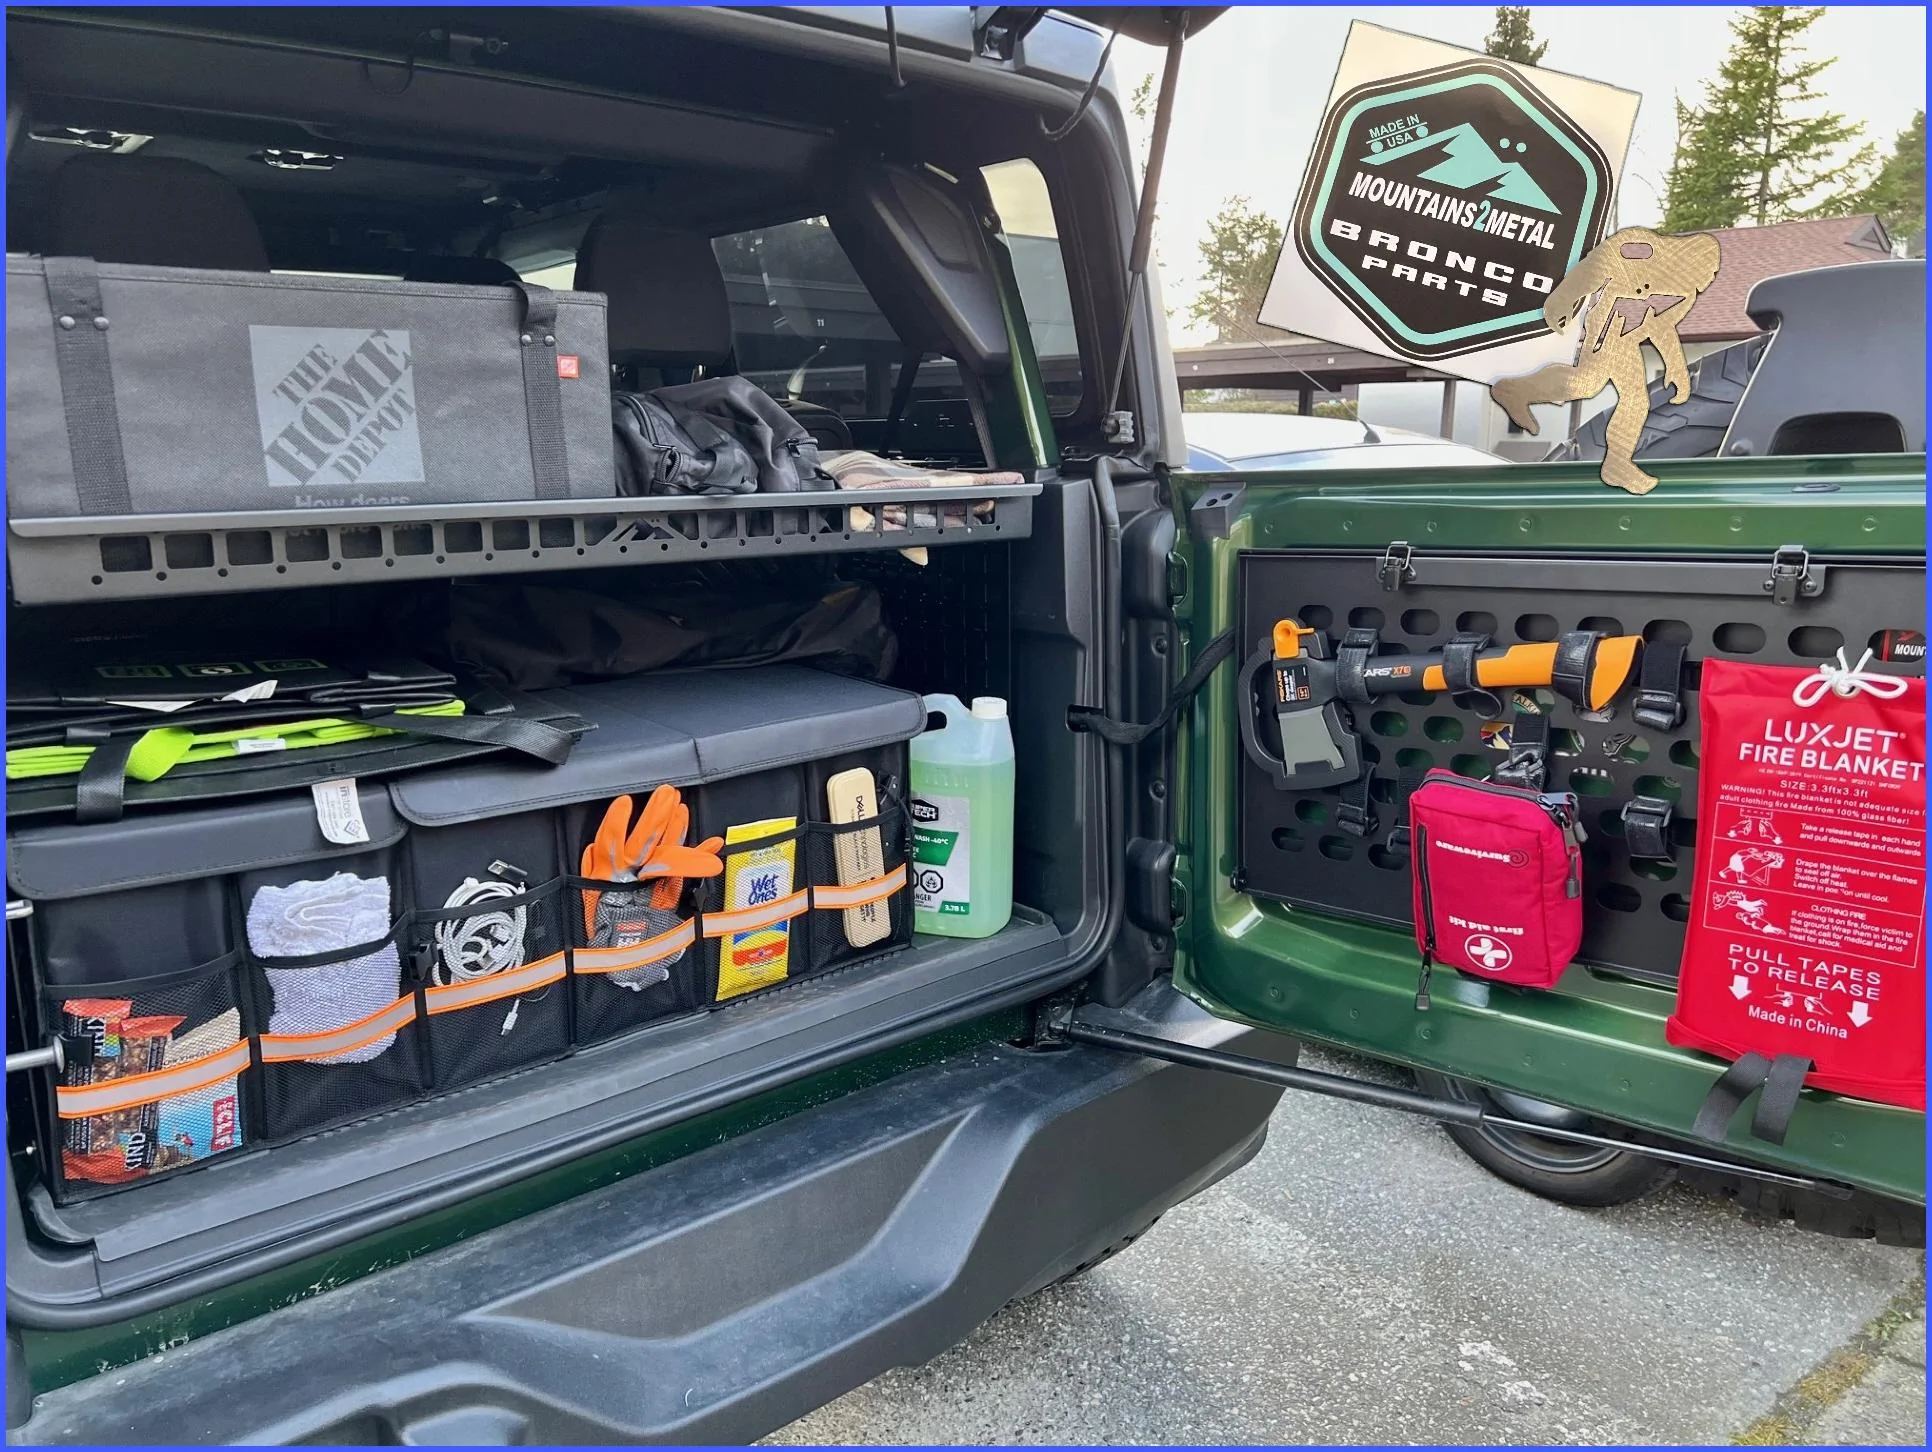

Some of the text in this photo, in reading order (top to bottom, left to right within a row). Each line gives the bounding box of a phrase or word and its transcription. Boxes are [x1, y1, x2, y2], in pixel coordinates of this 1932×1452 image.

[272, 343, 338, 406] THE
[264, 329, 413, 487] HOME
[331, 388, 415, 482] DEPOT
[1738, 742, 1925, 781] FIRE BLANKET
[1719, 794, 1740, 802] adult
[1740, 796, 1773, 808] clothing
[1774, 800, 1789, 809] fire
[1790, 803, 1813, 812] Made
[1814, 805, 1834, 814] from
[1836, 808, 1860, 818] 100%
[1861, 812, 1885, 822] glass
[1720, 783, 1765, 795] WARNING!
[1767, 789, 1785, 798] This
[1786, 791, 1800, 800] fire
[1801, 793, 1832, 804] blanket
[1833, 796, 1841, 805] is
[1843, 799, 1857, 807] not
[1859, 801, 1899, 813] adequate
[1901, 807, 1920, 816] size
[911, 809, 936, 819] ECH
[1799, 832, 1922, 857] and pull downwards and outwards
[1800, 822, 1818, 831] Take
[1825, 827, 1852, 837] release
[1853, 830, 1870, 840] tape
[1870, 832, 1878, 840] in
[1881, 834, 1900, 843] each
[1901, 837, 1921, 847] hand
[750, 873, 779, 892] Wet
[1794, 872, 1819, 882] Switch
[1819, 877, 1830, 885] off
[1819, 862, 1831, 870] the
[1832, 864, 1860, 875] blanket
[1860, 869, 1878, 878] over
[1878, 872, 1891, 880] the
[1891, 874, 1918, 885] flames
[748, 888, 778, 905] Ones
[914, 892, 932, 902] NGER
[1793, 880, 1816, 890] Leave
[1816, 883, 1825, 892] in
[1824, 886, 1854, 897] posion
[1854, 891, 1871, 899] until
[1448, 915, 1467, 928] kit
[1468, 921, 1492, 931] aid
[1790, 917, 1803, 926] the
[1852, 928, 1872, 939] them
[1872, 932, 1880, 940] in
[1880, 934, 1894, 942] the
[1894, 936, 1909, 946] fire
[1797, 911, 1827, 923] clothing
[1827, 916, 1835, 924] is
[1880, 927, 1904, 937] victim
[1904, 931, 1914, 939] to
[1806, 934, 1818, 943] for
[1832, 932, 1843, 940] for
[1843, 936, 1874, 947] medical
[1873, 941, 1887, 950] aid
[1887, 944, 1903, 953] and
[1728, 943, 1881, 985] PULL TAPES
[1728, 957, 1881, 1001] TO RELEASE
[1748, 1004, 1849, 1039] Made in China
